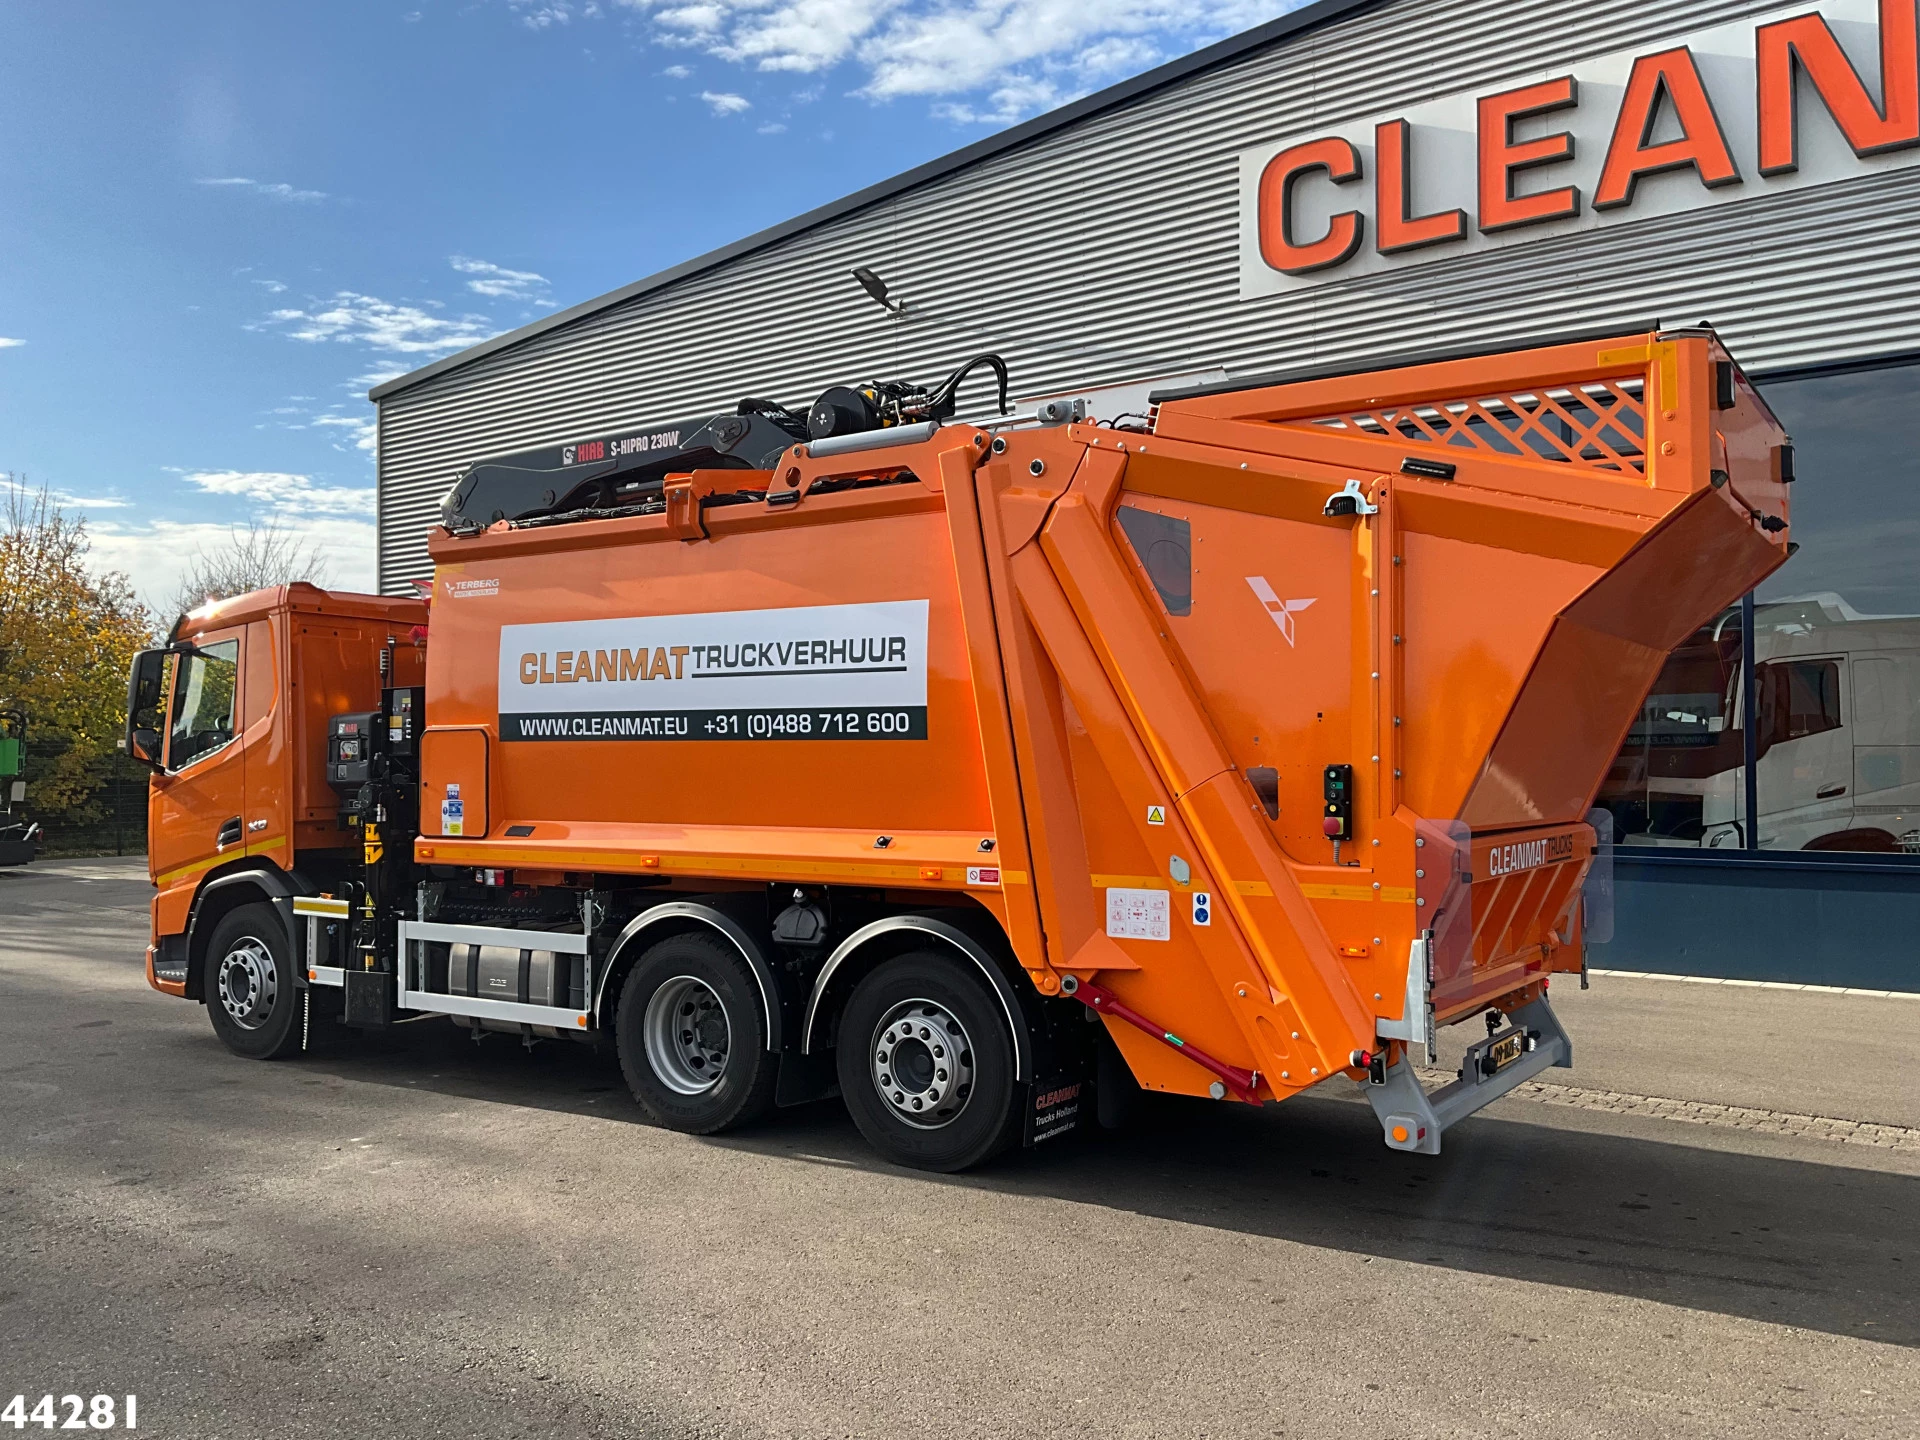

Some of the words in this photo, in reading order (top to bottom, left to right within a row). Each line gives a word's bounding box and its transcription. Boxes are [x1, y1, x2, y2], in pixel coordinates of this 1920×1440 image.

[1258, 0, 1920, 276] CLEAN
[577, 441, 605, 462] HIAB
[610, 436, 649, 456] S-HIPRO
[651, 430, 680, 450] 230W
[455, 579, 500, 590] TERBERG
[519, 646, 690, 685] CLEANMAT
[692, 636, 906, 669] TRUCKVERHUUR
[519, 716, 688, 736] WWW.CLEANMAT.EU
[704, 714, 738, 734] +31
[747, 713, 812, 738] (0)488
[818, 712, 860, 733] 712
[866, 712, 910, 733] 600
[1489, 838, 1548, 876] CLEANMAT
[1548, 833, 1573, 857] TRUCKS
[1035, 1083, 1081, 1110] CLEANMAT
[1035, 1112, 1055, 1126] Trucks
[1056, 1103, 1078, 1119] Holland
[1033, 1121, 1076, 1142] www.cleanmat.eu
